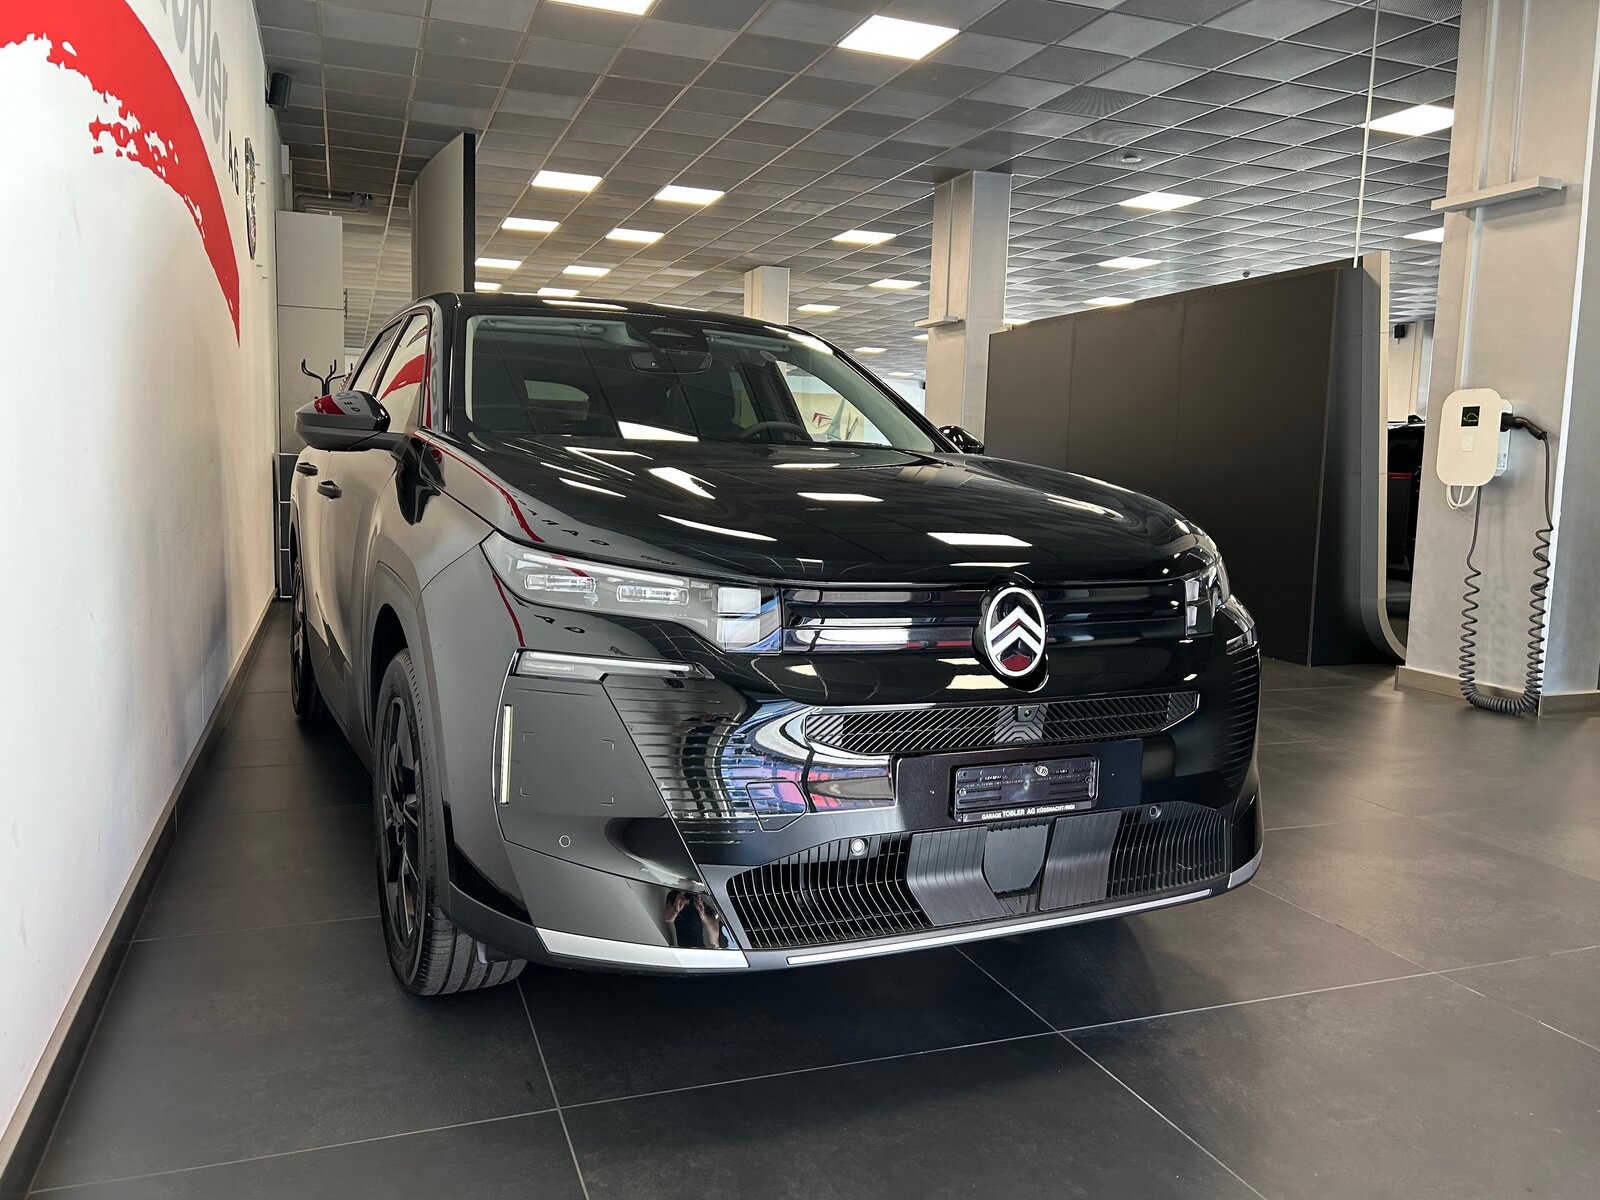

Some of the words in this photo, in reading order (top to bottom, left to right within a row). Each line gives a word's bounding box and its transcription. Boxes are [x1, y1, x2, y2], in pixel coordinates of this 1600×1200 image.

[160, 0, 228, 161] bler
[228, 129, 239, 196] AG
[981, 812, 1002, 820] GARAGE
[1002, 808, 1025, 818] TOBLER
[1026, 807, 1036, 815] AG
